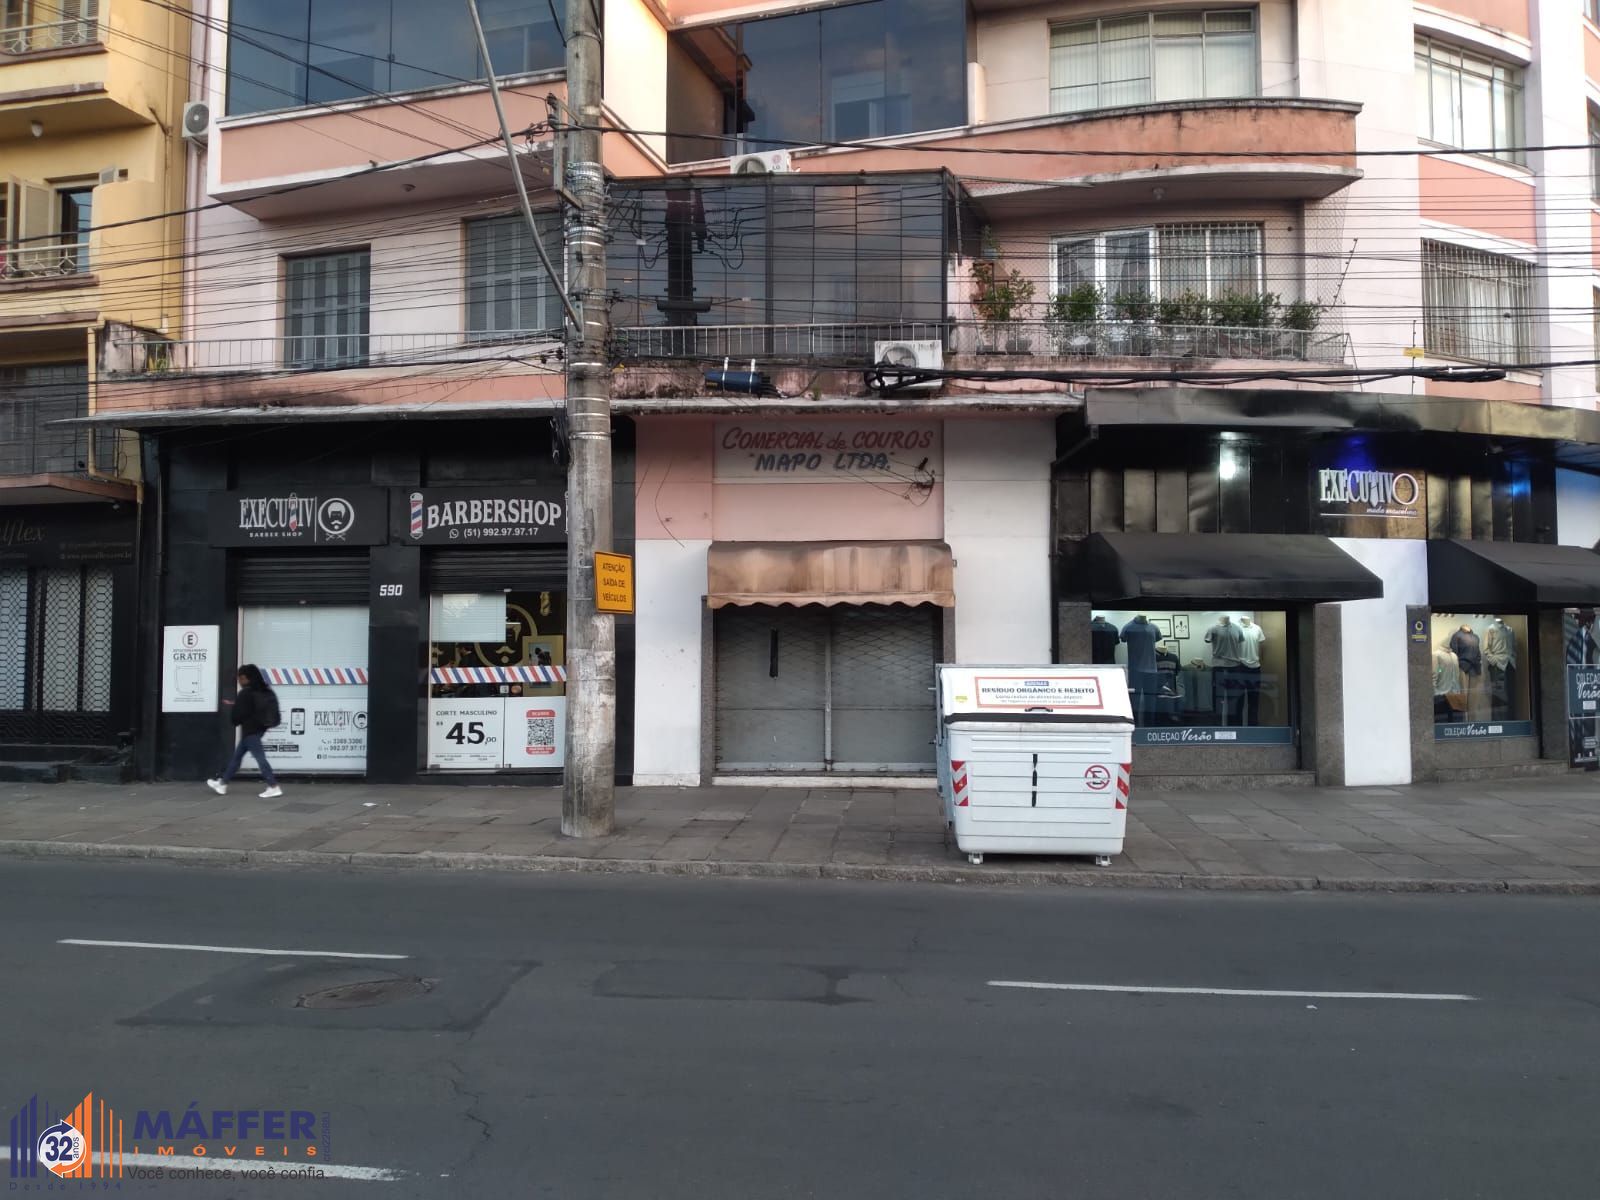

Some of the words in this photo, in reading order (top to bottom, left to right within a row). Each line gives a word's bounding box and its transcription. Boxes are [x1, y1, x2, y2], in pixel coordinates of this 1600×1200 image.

[722, 427, 824, 450] COMERCIAL
[826, 431, 847, 450] de
[851, 430, 933, 449] COUROS
[1318, 468, 1419, 507] EXECUTIVO
[427, 499, 562, 530] BARBERSHOP
[463, 527, 481, 538] (51)
[483, 527, 539, 537] 992.97.97.17
[602, 562, 625, 573] ATENÇÃO
[618, 579, 626, 588] DE
[379, 584, 403, 597] 590
[602, 592, 627, 603] VEÍCULOS
[1180, 728, 1213, 742] Verão
